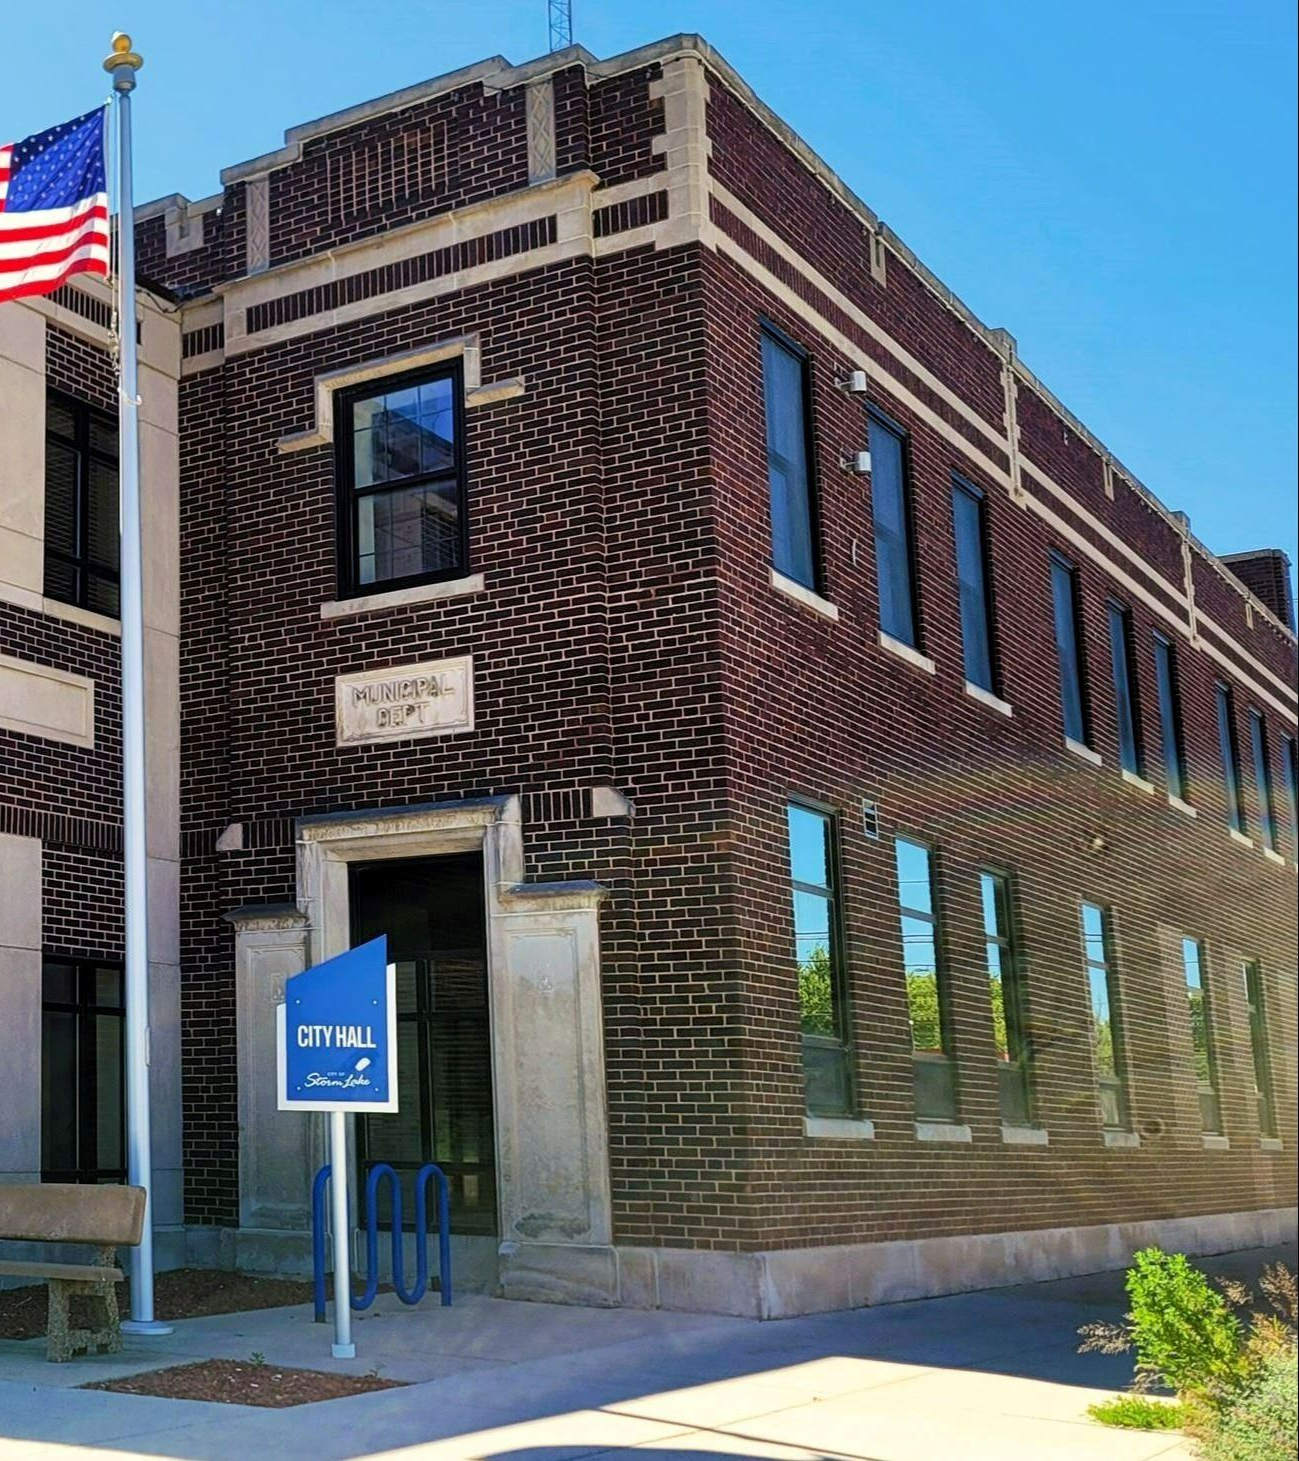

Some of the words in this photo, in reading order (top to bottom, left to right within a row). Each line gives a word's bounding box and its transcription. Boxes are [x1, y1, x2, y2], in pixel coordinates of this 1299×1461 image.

[351, 672, 455, 709] MUNICIPAL
[376, 701, 431, 728] DEPT
[297, 1025, 334, 1048] CITY
[335, 1025, 377, 1049] HALL
[304, 1072, 343, 1088] Storm
[341, 1073, 372, 1089] Lake
